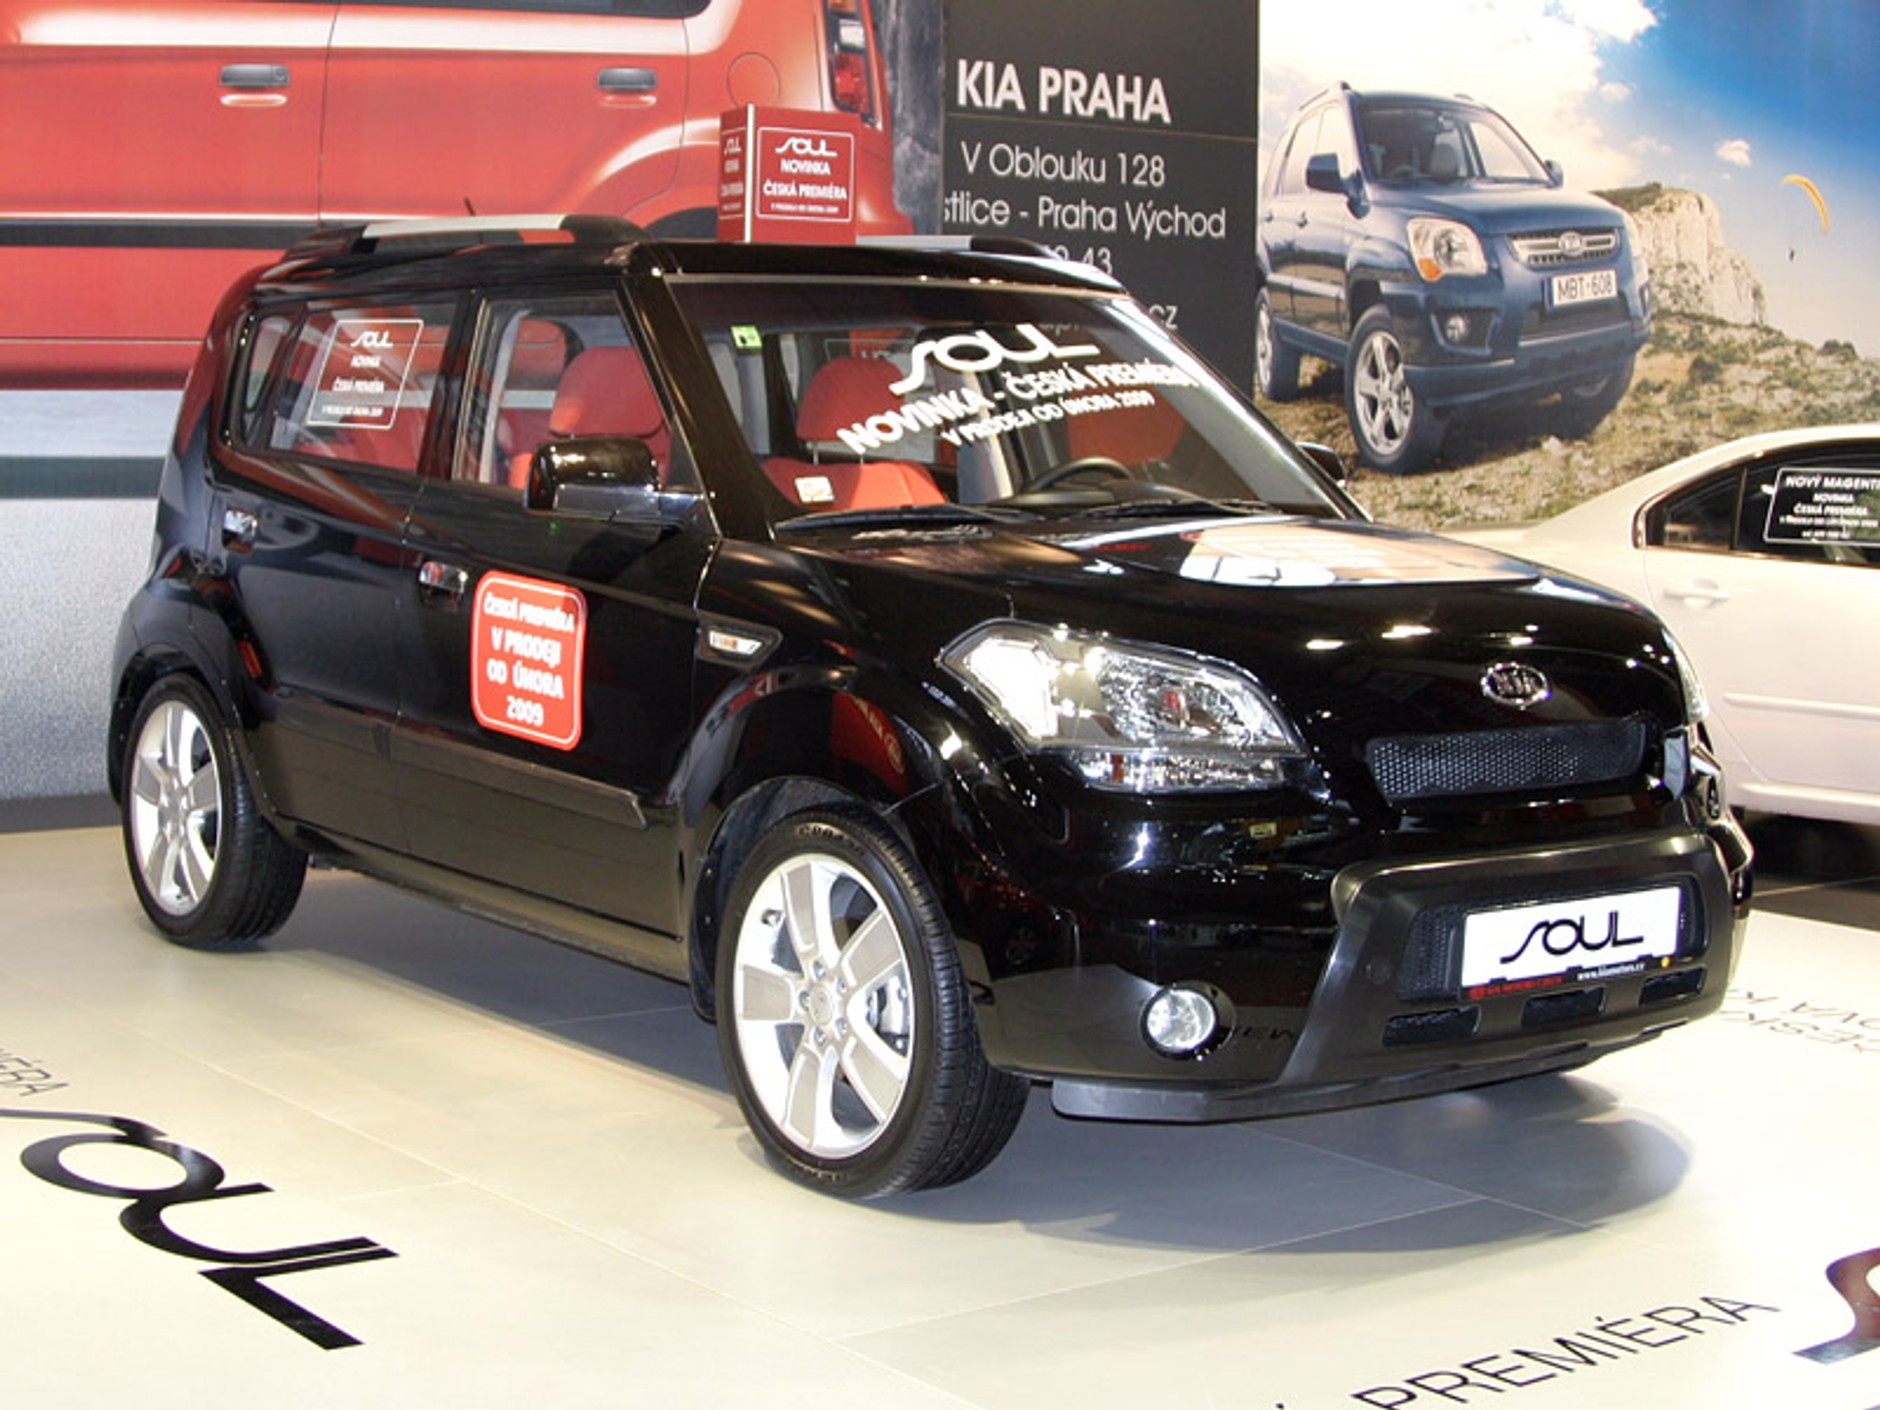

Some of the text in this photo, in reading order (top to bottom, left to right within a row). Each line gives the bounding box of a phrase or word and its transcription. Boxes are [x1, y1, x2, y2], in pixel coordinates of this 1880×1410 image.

[957, 58, 1172, 125] KIA PRAHA
[774, 136, 839, 158] SOUL
[779, 157, 832, 176] NOVINKA
[960, 140, 1167, 188] V Oblouku 128
[762, 177, 798, 198] ČESKÁ
[1037, 195, 1117, 233] Praha
[1125, 199, 1227, 241] Východ
[888, 322, 1101, 396] SOUL
[836, 387, 996, 454] NOVINKA
[1001, 361, 1098, 400] ČESKÁ
[1032, 404, 1065, 422] OD
[491, 626, 504, 651] V
[486, 657, 565, 700] OD ÚNORA
[506, 695, 545, 728] 2009
[1499, 910, 1645, 965] SOUL
[1351, 1295, 1781, 1410] PREMIÉRA
